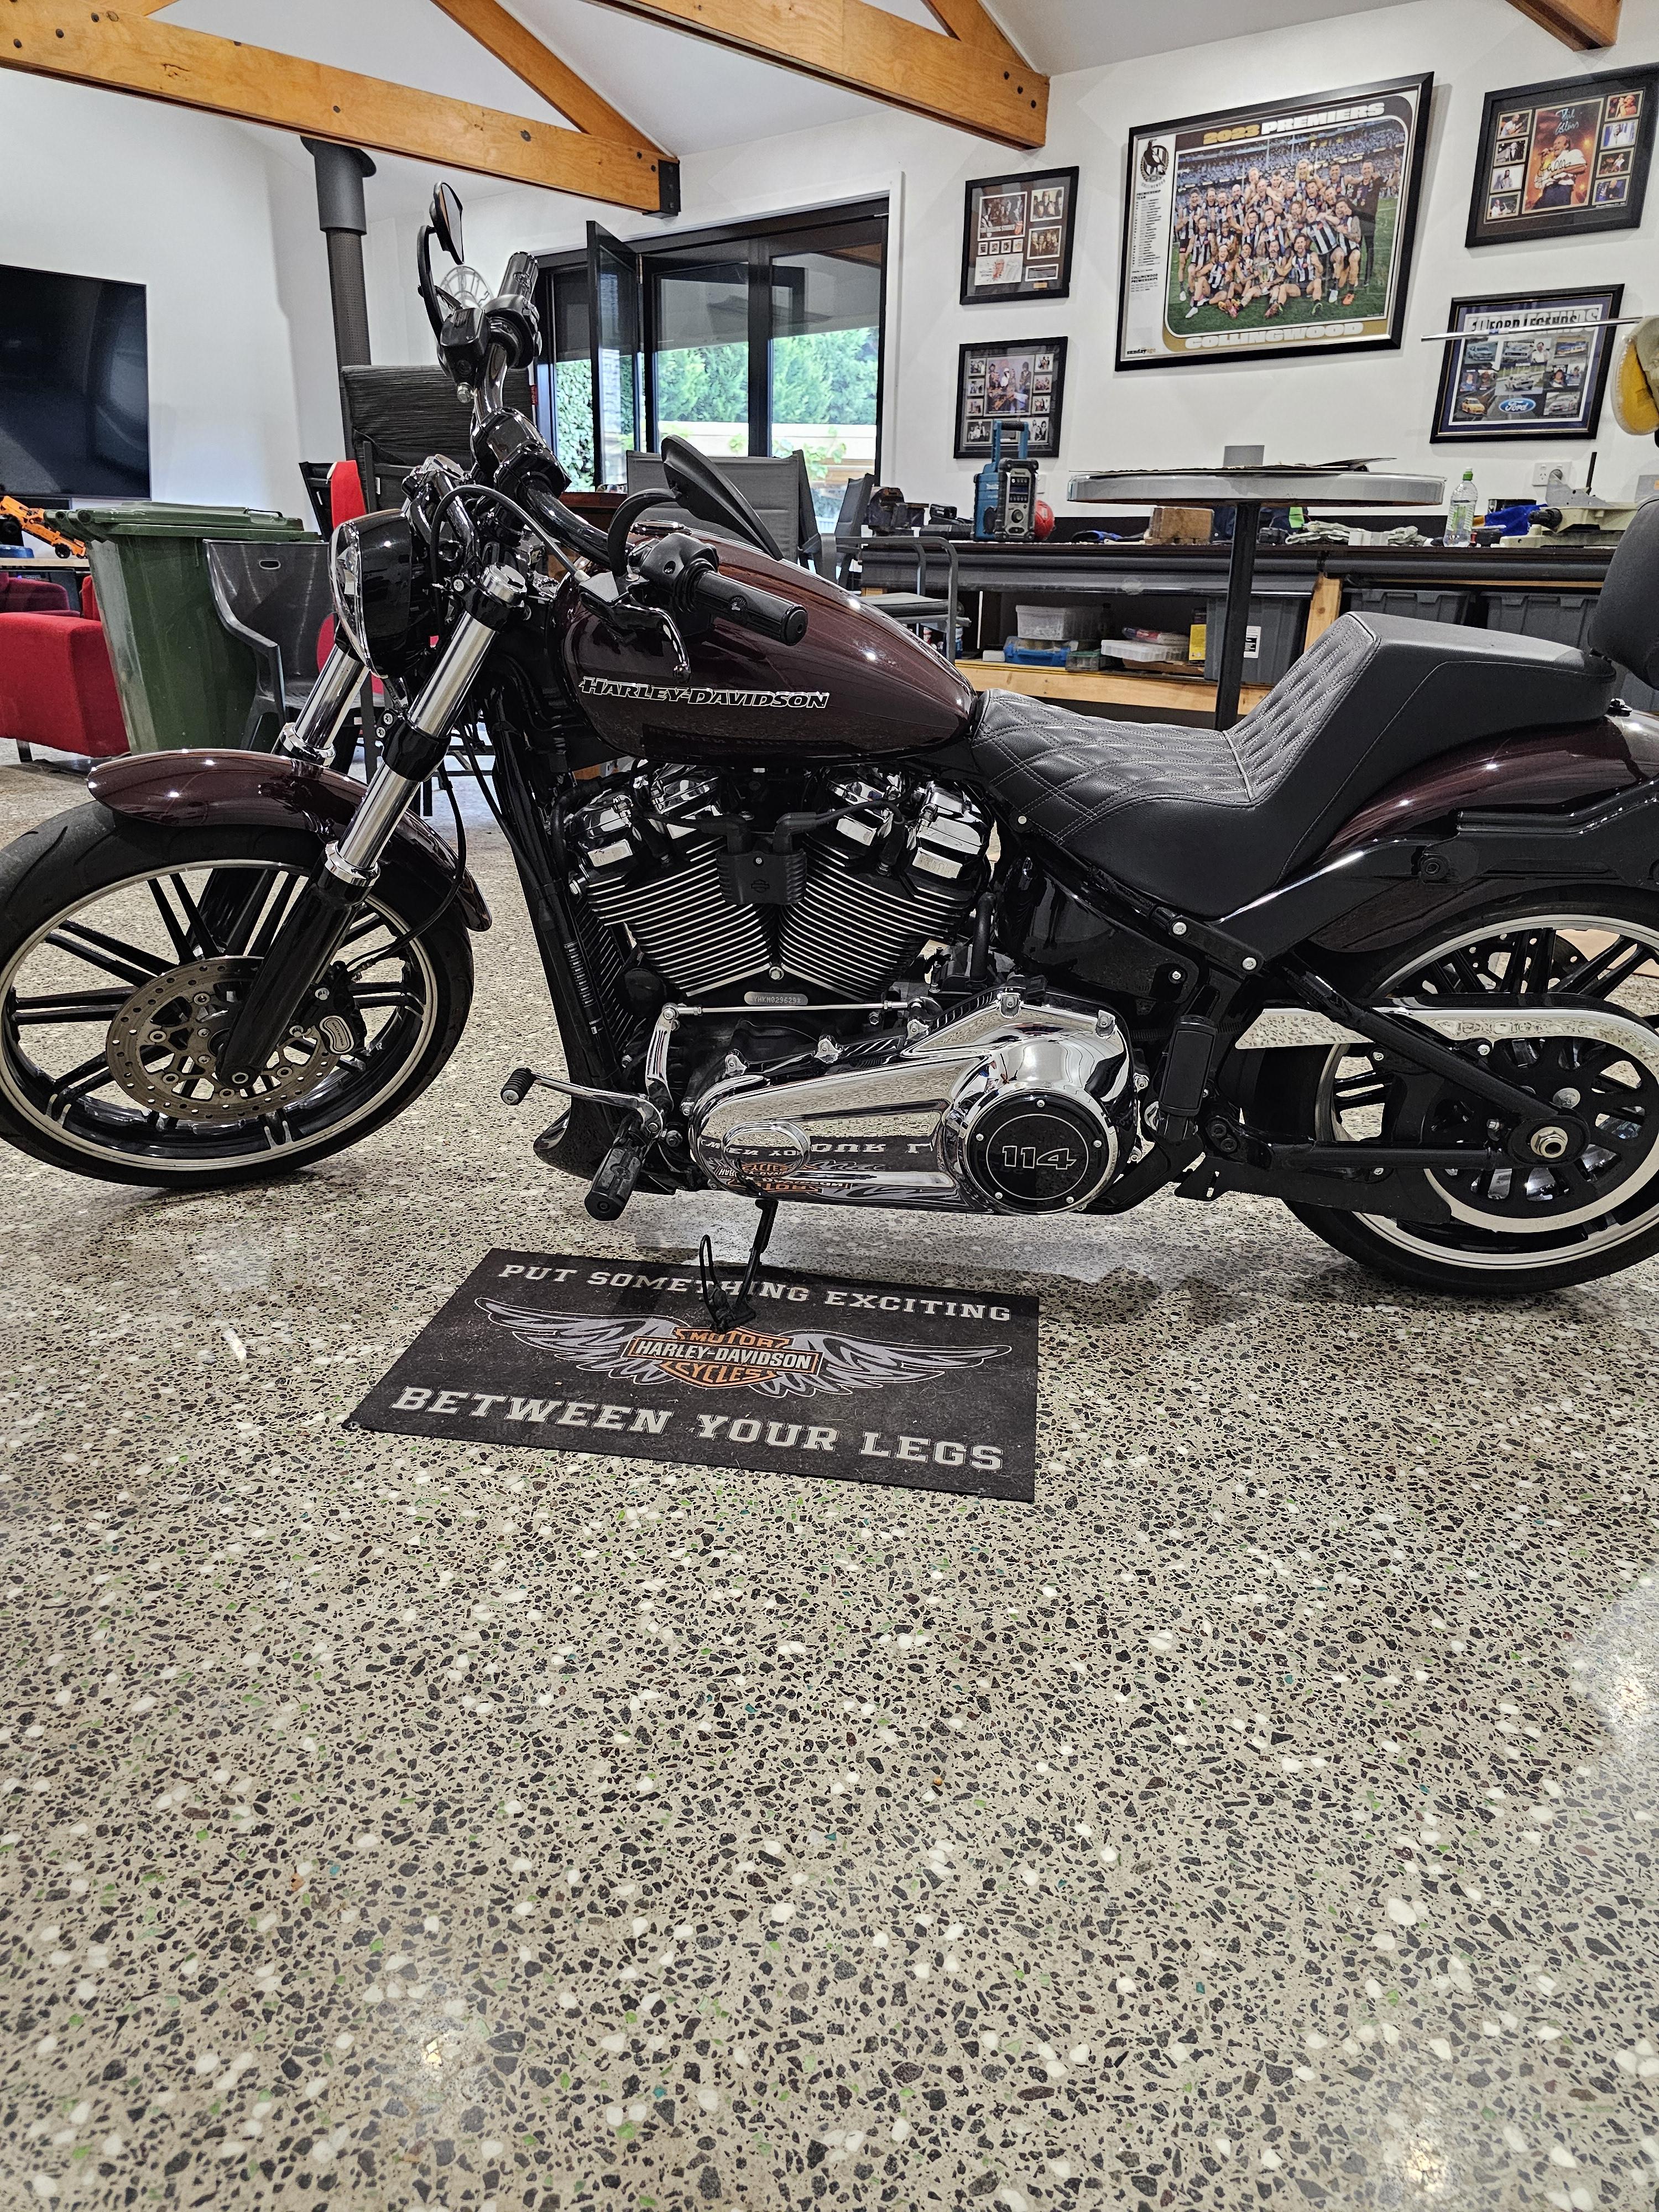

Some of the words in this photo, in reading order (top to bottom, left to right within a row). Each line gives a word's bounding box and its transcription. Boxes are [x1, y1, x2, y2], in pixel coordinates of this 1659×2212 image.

[1203, 124, 1260, 145] 2023
[1261, 102, 1385, 135] PREMIERS
[1185, 322, 1364, 349] COLLINGWOOD
[1504, 400, 1528, 412] Ford
[578, 676, 830, 708] HARLEY-DAVIDSON
[1001, 1145, 1077, 1170] 114
[498, 1264, 578, 1282] PUT
[824, 1290, 1012, 1321] EXCITING
[689, 1331, 774, 1348] MOTOR
[636, 1340, 812, 1370] HARLEY-DAVIDSON
[675, 1360, 766, 1383] CYCLES
[389, 1386, 674, 1435] BETWEEN
[696, 1413, 839, 1452] YOUR
[858, 1431, 1003, 1471] LEGS
